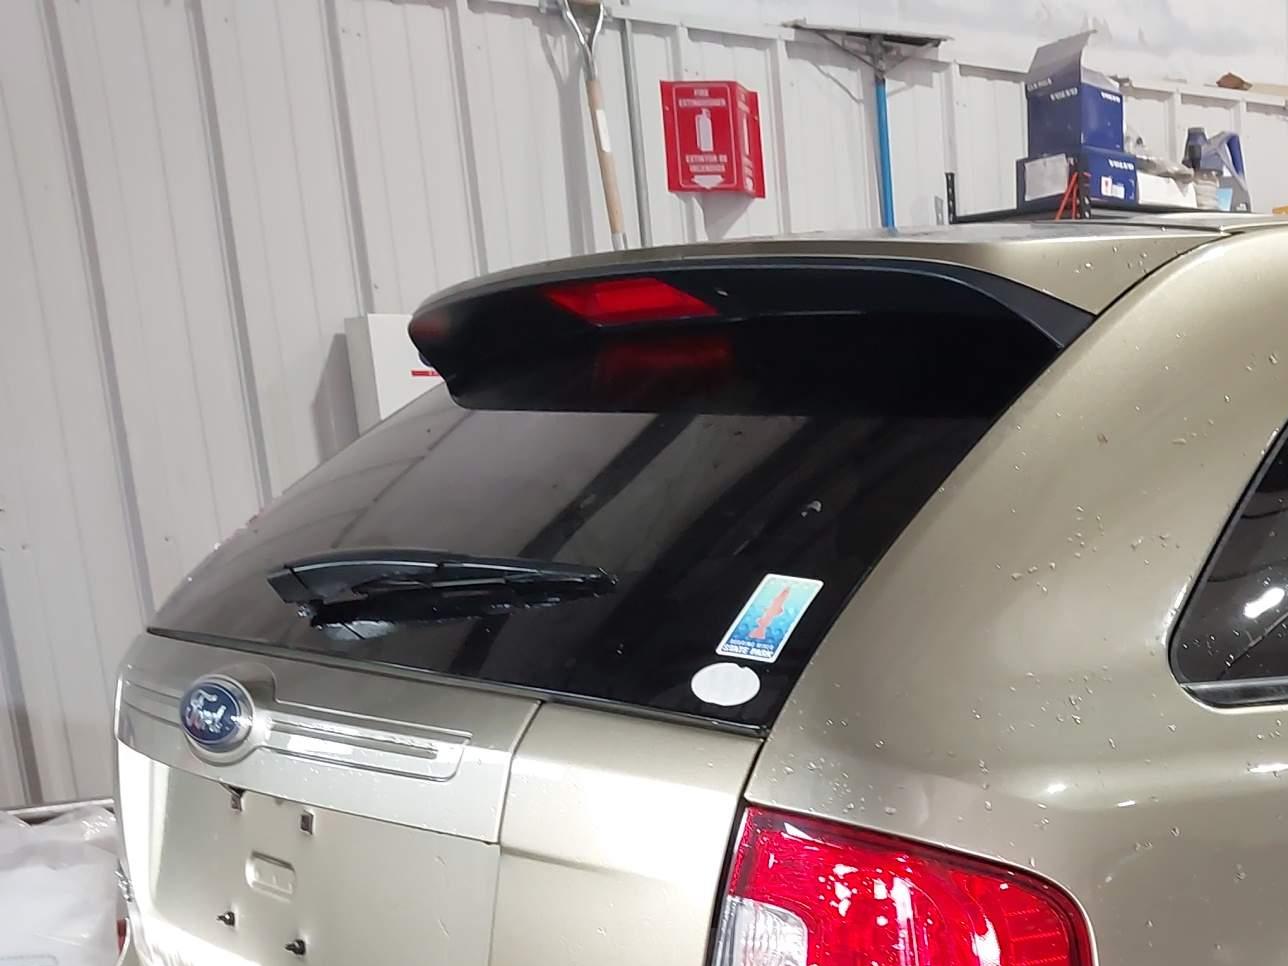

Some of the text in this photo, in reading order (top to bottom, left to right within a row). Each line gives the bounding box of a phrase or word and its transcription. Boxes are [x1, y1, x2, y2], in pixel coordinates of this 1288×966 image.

[1050, 87, 1078, 101] VOLVO
[1108, 159, 1135, 171] VOLVO
[186, 689, 227, 733] Ford
